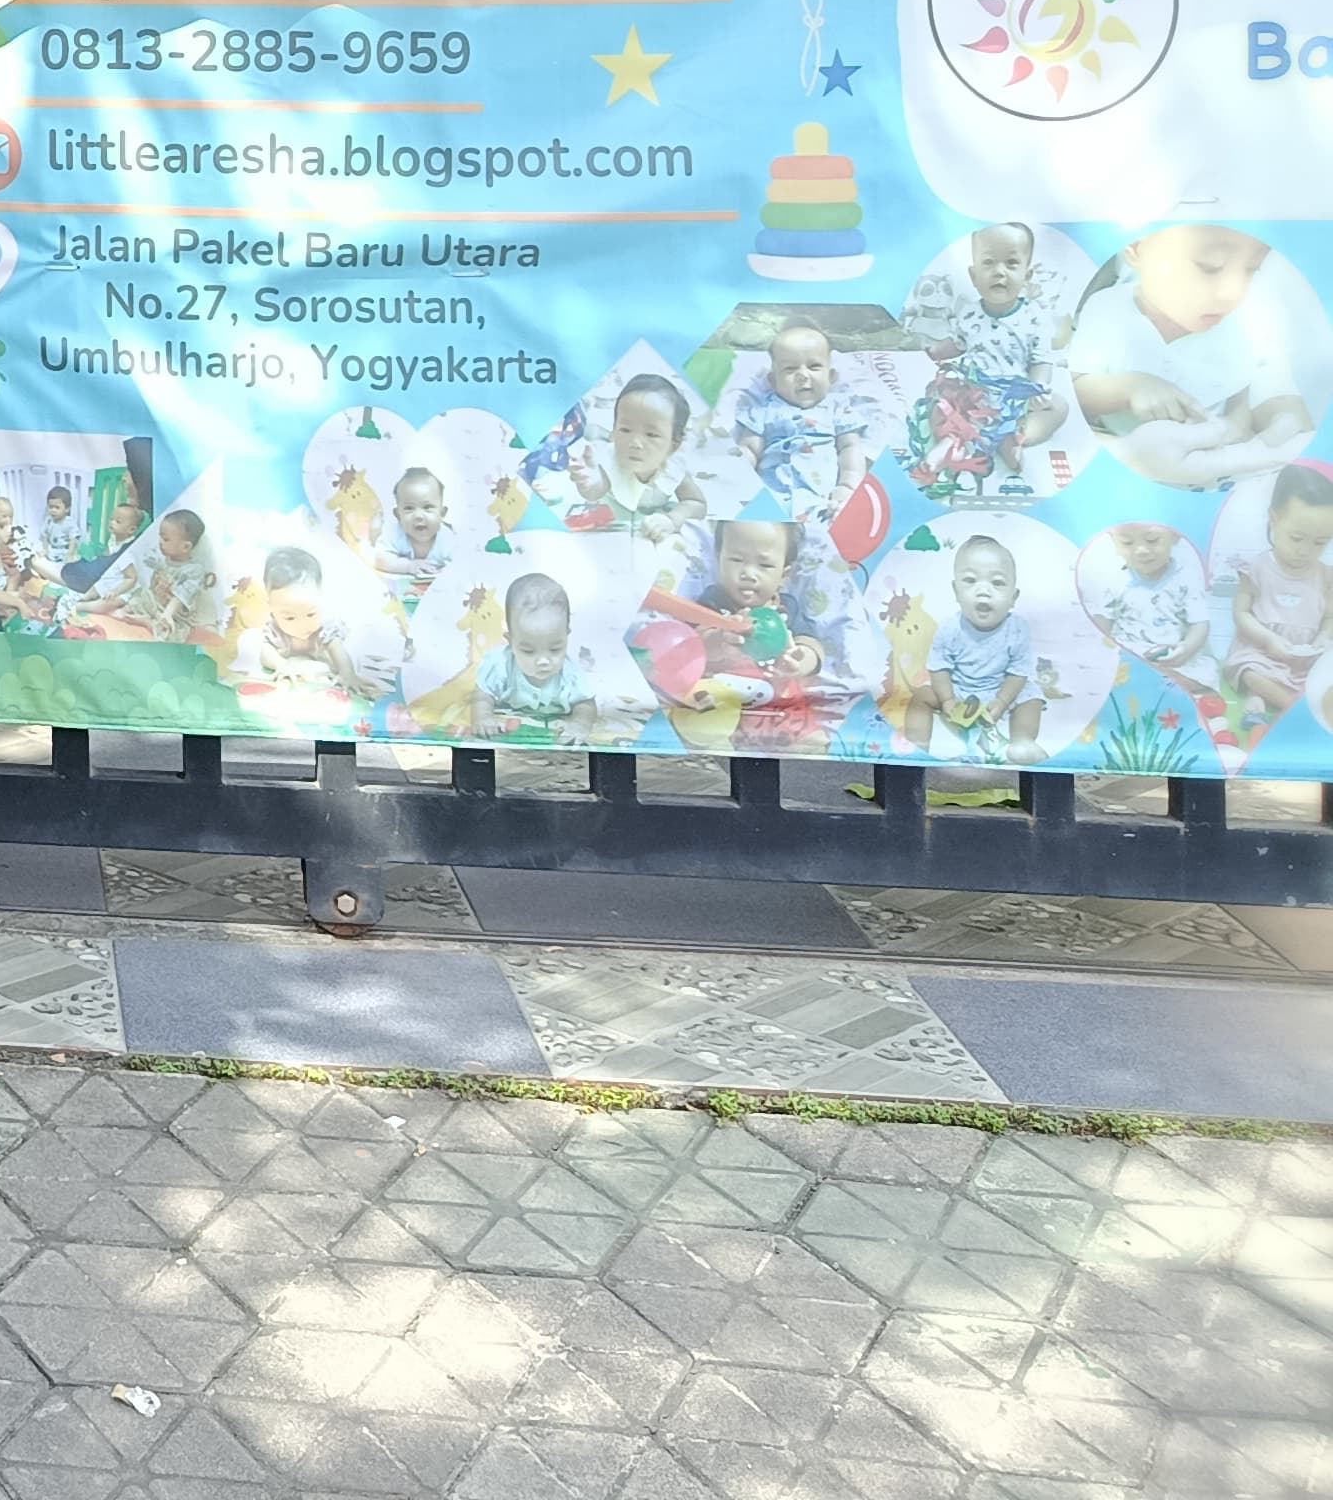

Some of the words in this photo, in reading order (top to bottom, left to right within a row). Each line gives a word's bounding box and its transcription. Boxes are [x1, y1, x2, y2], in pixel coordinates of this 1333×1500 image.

[41, 28, 471, 74] 0813-2885-9659
[48, 128, 693, 188] littlearesha.blogspot.com
[52, 225, 156, 263] Jalan
[172, 228, 290, 267] Pakel
[304, 232, 404, 268] Baru
[420, 234, 540, 268] Utara
[105, 282, 239, 326] No.27,
[254, 287, 486, 330] Sorosutan,
[39, 336, 296, 388] Umbulharjo,
[310, 344, 557, 390] Yogyakarta
